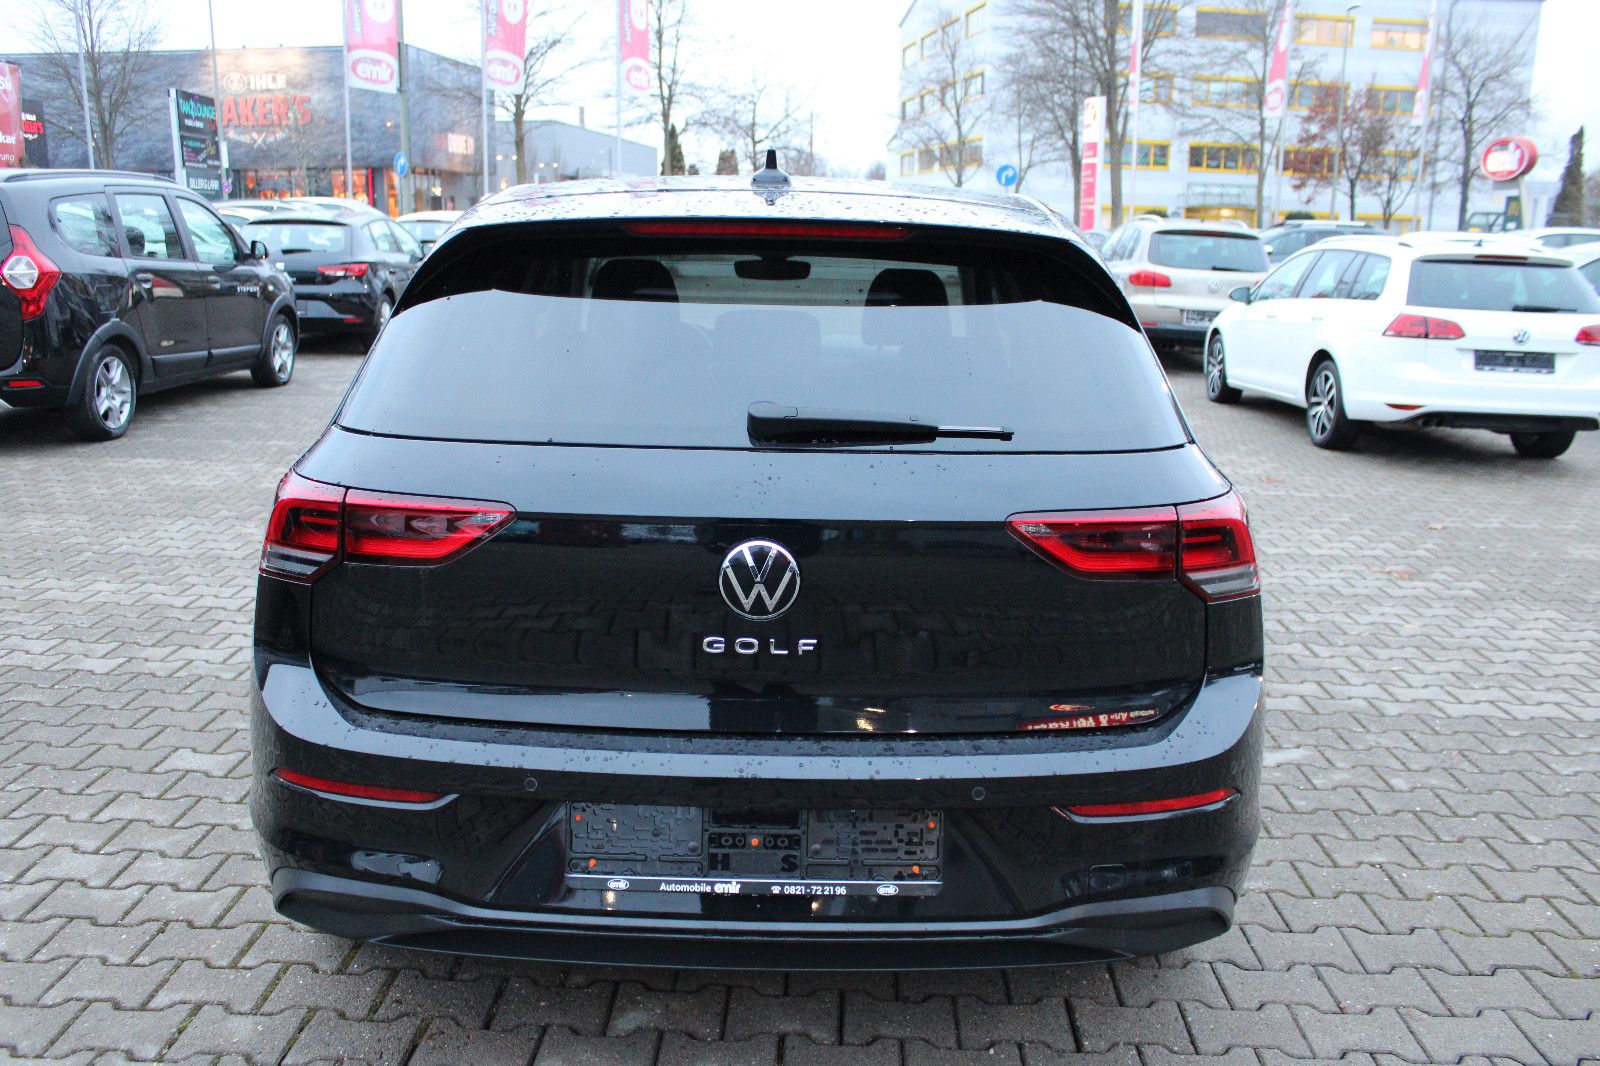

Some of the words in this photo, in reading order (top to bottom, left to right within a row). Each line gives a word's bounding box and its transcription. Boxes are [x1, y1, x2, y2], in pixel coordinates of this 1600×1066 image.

[249, 73, 287, 90] IHLE
[215, 95, 313, 128] AKER'S
[703, 637, 818, 655] GOLF
[660, 882, 712, 892] Automobile
[714, 881, 741, 894] emir
